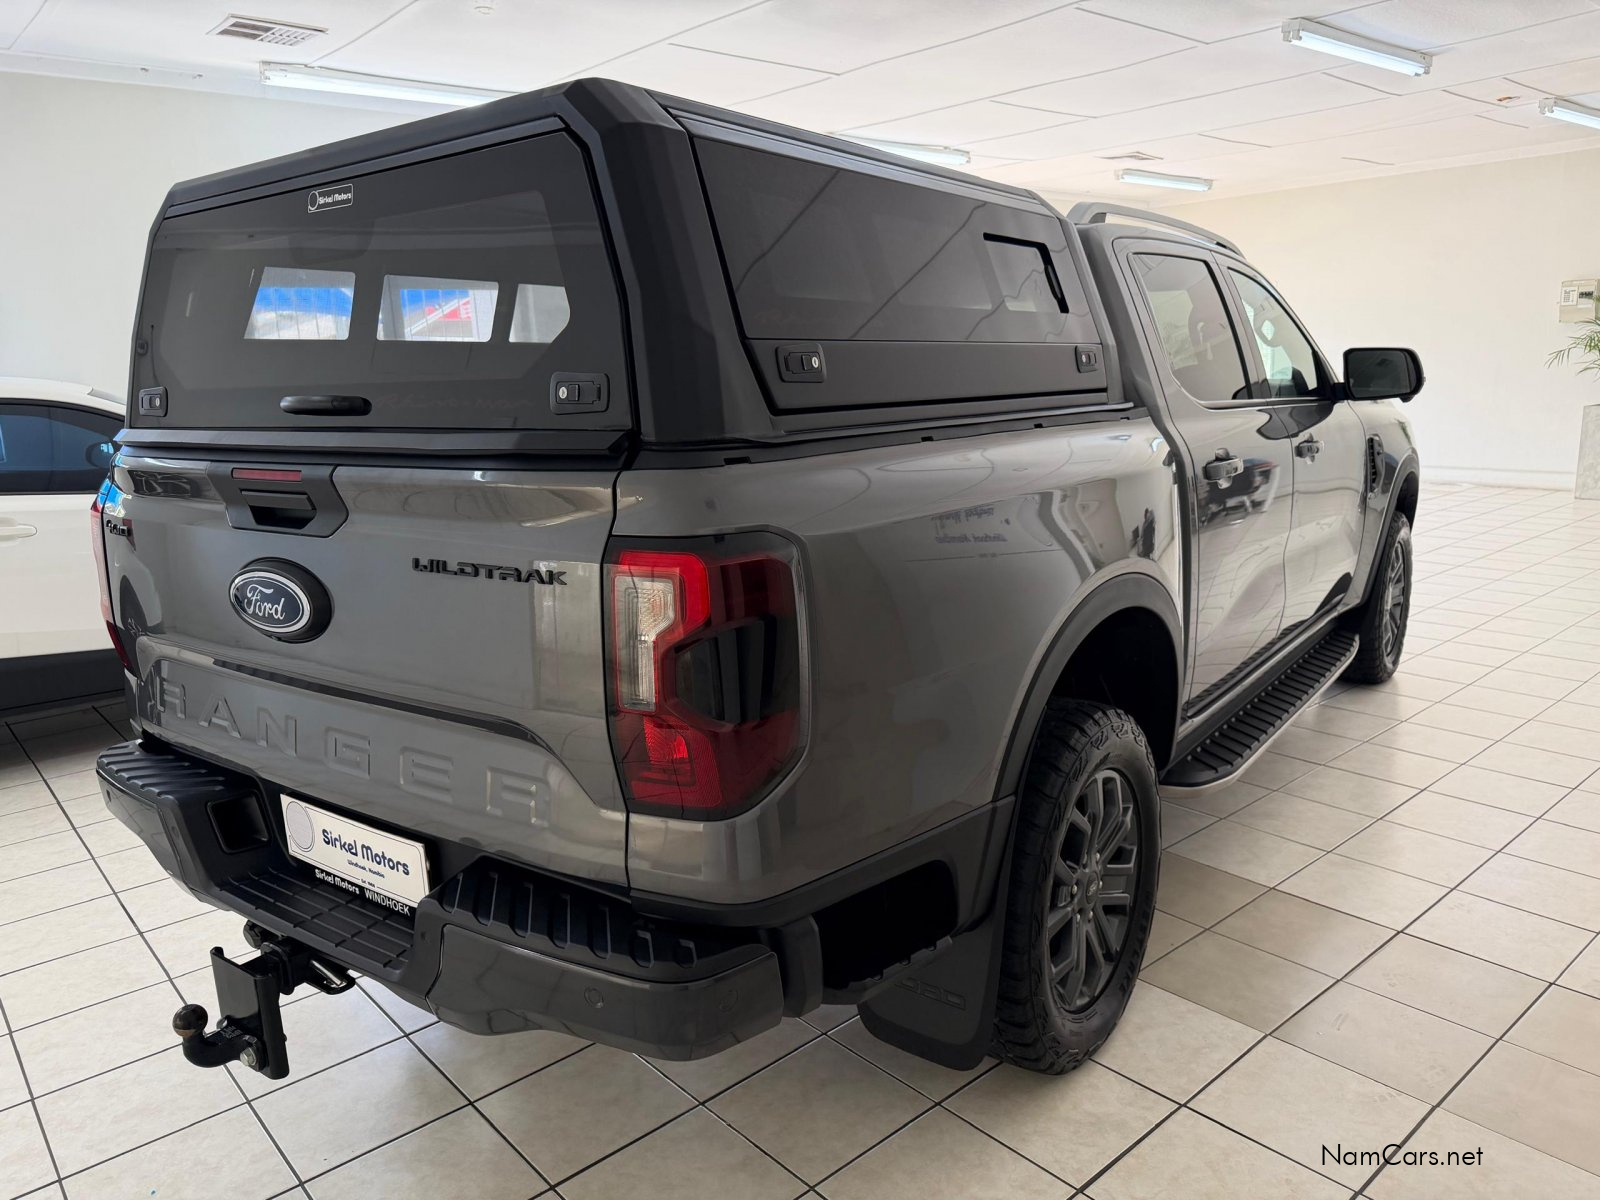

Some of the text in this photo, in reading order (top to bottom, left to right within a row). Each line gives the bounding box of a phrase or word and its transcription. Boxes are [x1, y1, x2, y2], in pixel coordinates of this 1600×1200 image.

[318, 192, 352, 205] Sirkel Motors
[411, 557, 568, 586] WILDTRAK
[244, 584, 286, 620] Ford
[155, 676, 552, 827] RANGER
[321, 828, 410, 876] Sirkel Motors
[315, 868, 334, 884] Sirkel
[335, 877, 360, 895] Motors
[364, 888, 411, 917] WINDHOEK
